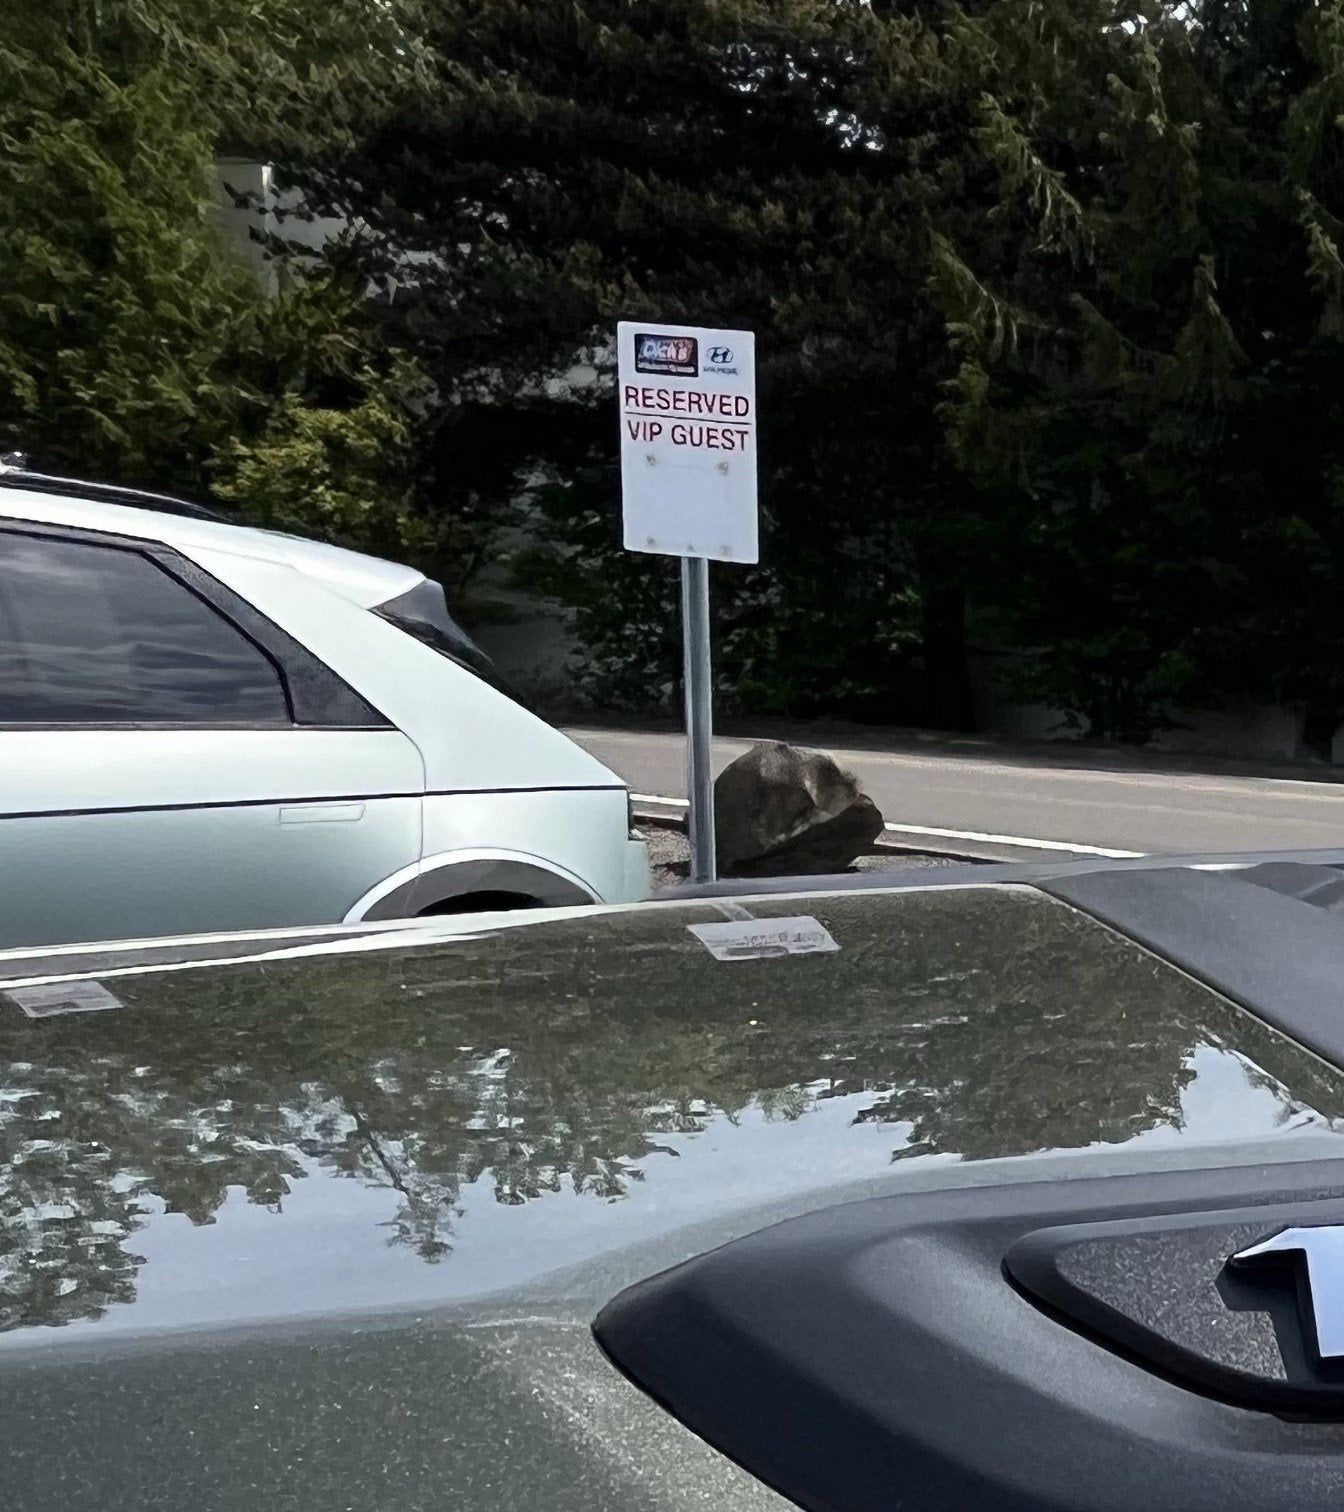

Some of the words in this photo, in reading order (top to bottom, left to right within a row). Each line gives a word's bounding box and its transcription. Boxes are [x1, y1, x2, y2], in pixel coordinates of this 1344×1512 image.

[624, 385, 750, 417] RESERVED
[627, 419, 663, 442] VIP
[671, 424, 749, 451] GUEST
